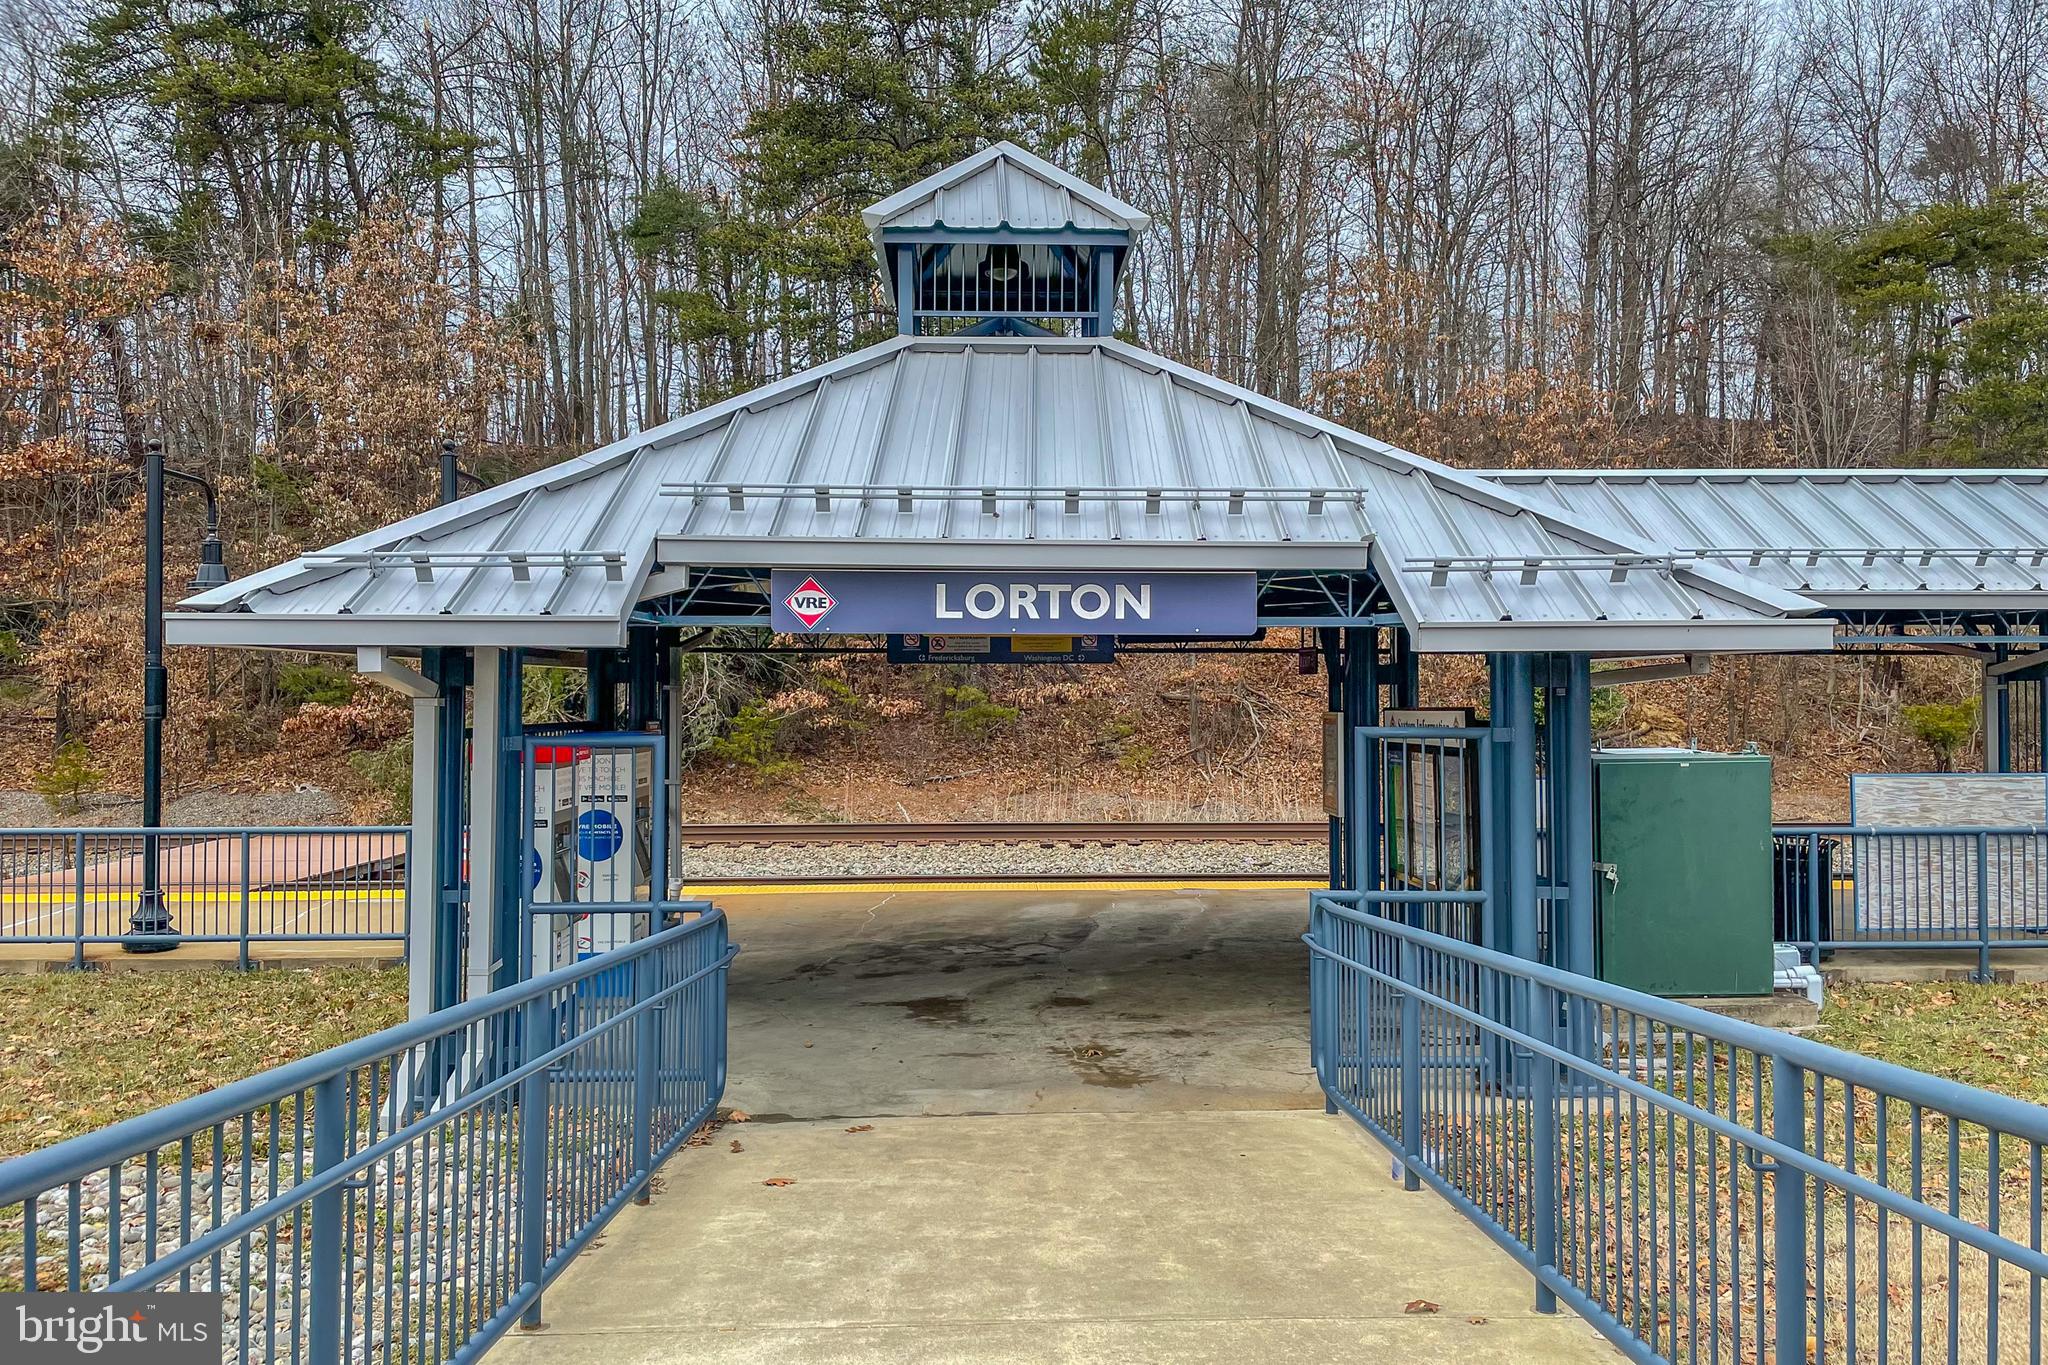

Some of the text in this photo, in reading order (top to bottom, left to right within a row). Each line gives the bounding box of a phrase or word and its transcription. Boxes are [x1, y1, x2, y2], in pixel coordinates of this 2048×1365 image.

[794, 596, 828, 609] VRE
[935, 583, 1150, 620] LORTON
[928, 654, 976, 663] Fredericksburg
[1024, 654, 1075, 663] Washington DC
